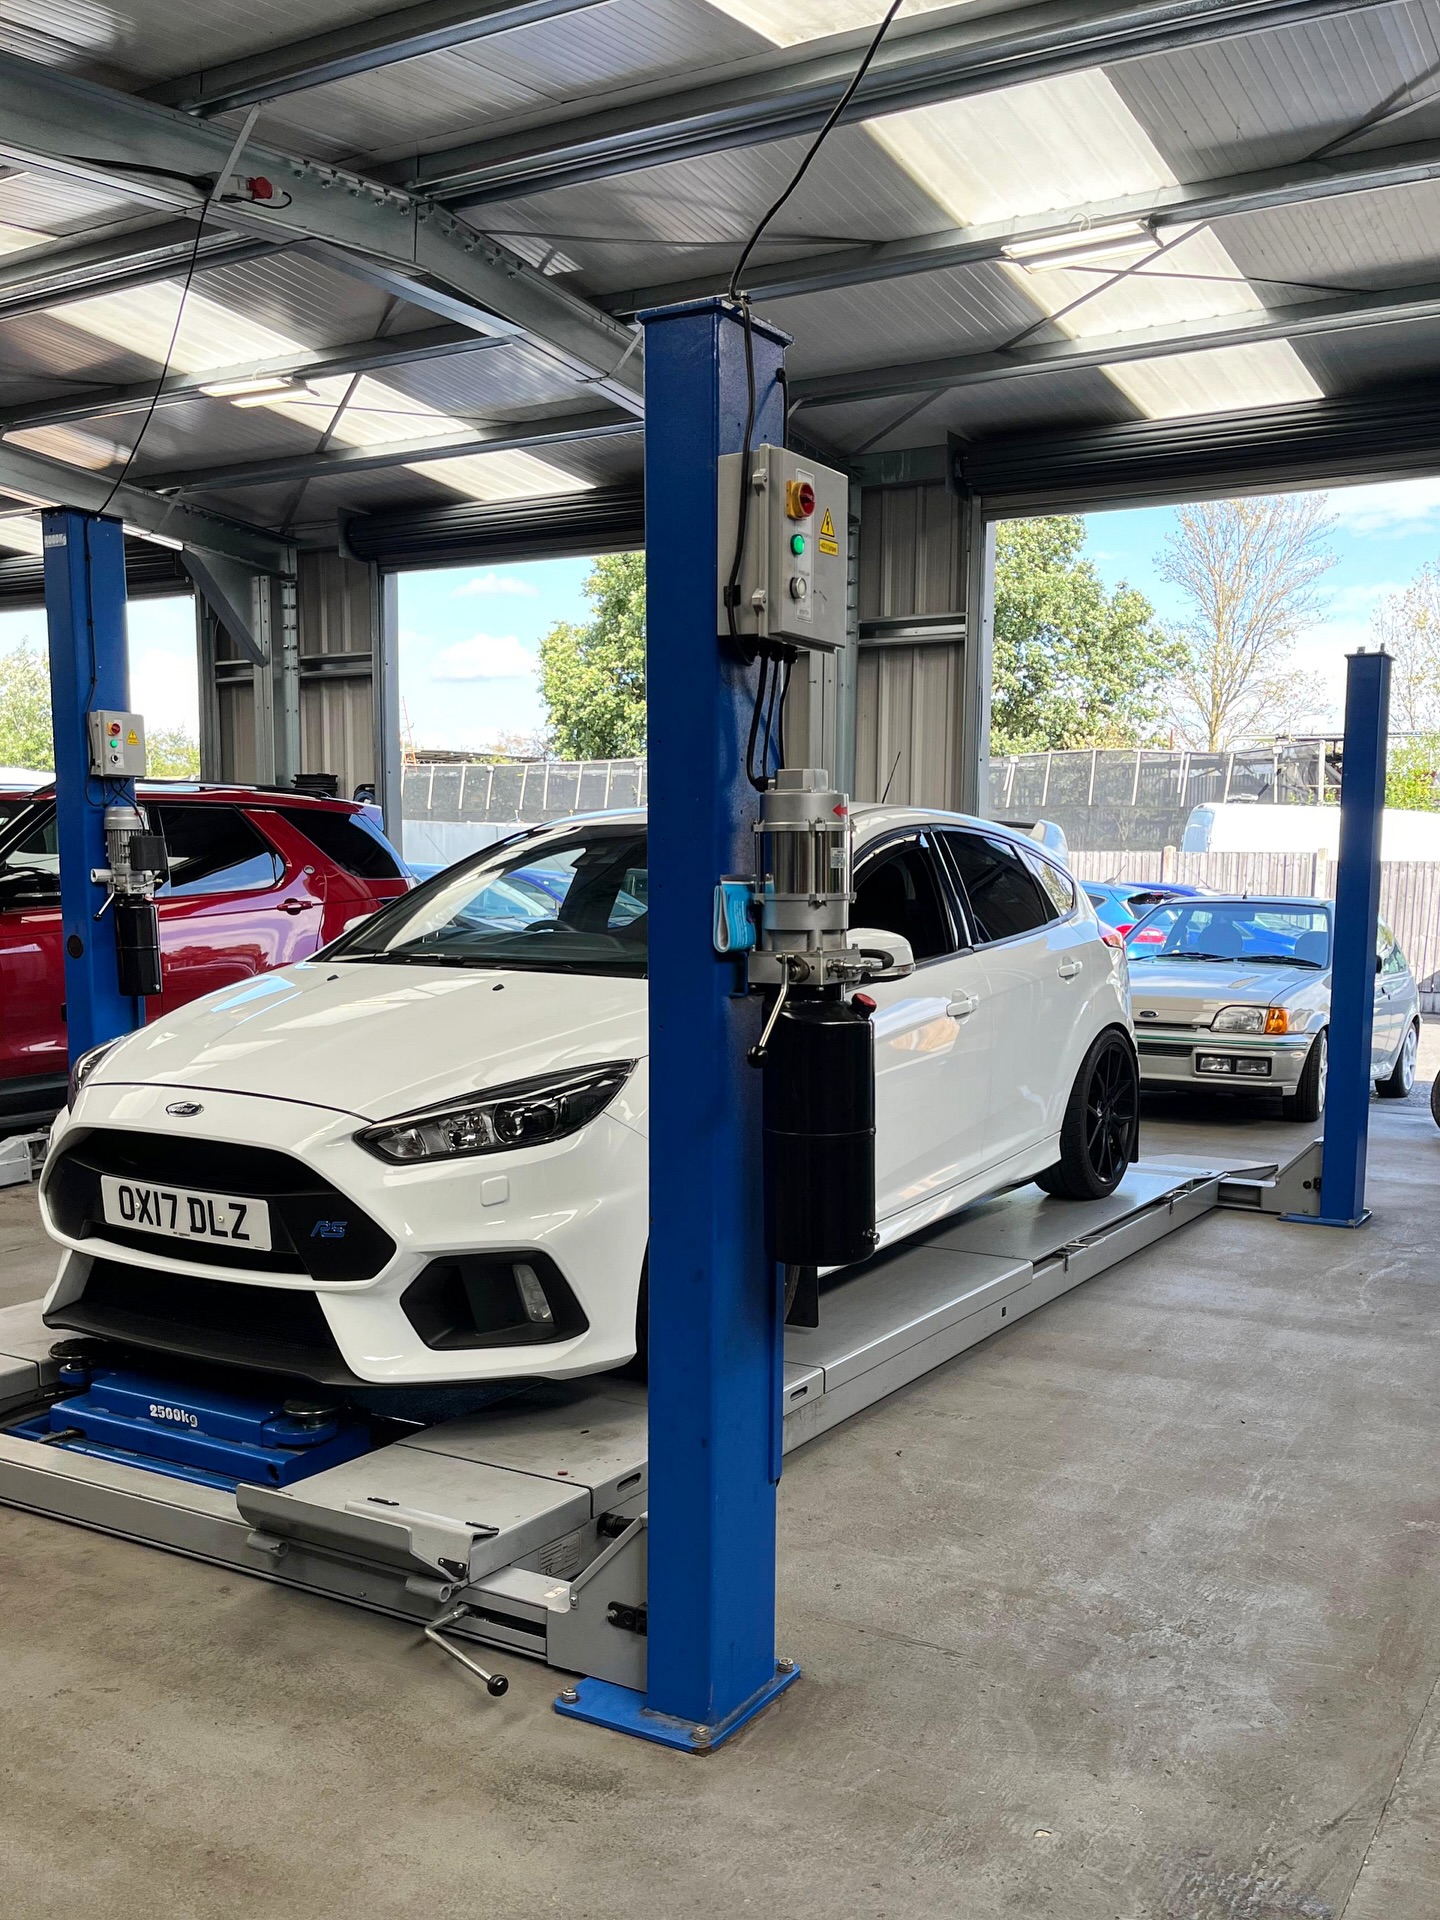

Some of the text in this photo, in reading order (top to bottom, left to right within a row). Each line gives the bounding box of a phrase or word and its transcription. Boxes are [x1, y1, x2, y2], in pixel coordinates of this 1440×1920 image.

[118, 1185, 250, 1241] OX17 DLZ
[310, 1220, 348, 1238] RS
[149, 1404, 198, 1428] 2500kg
